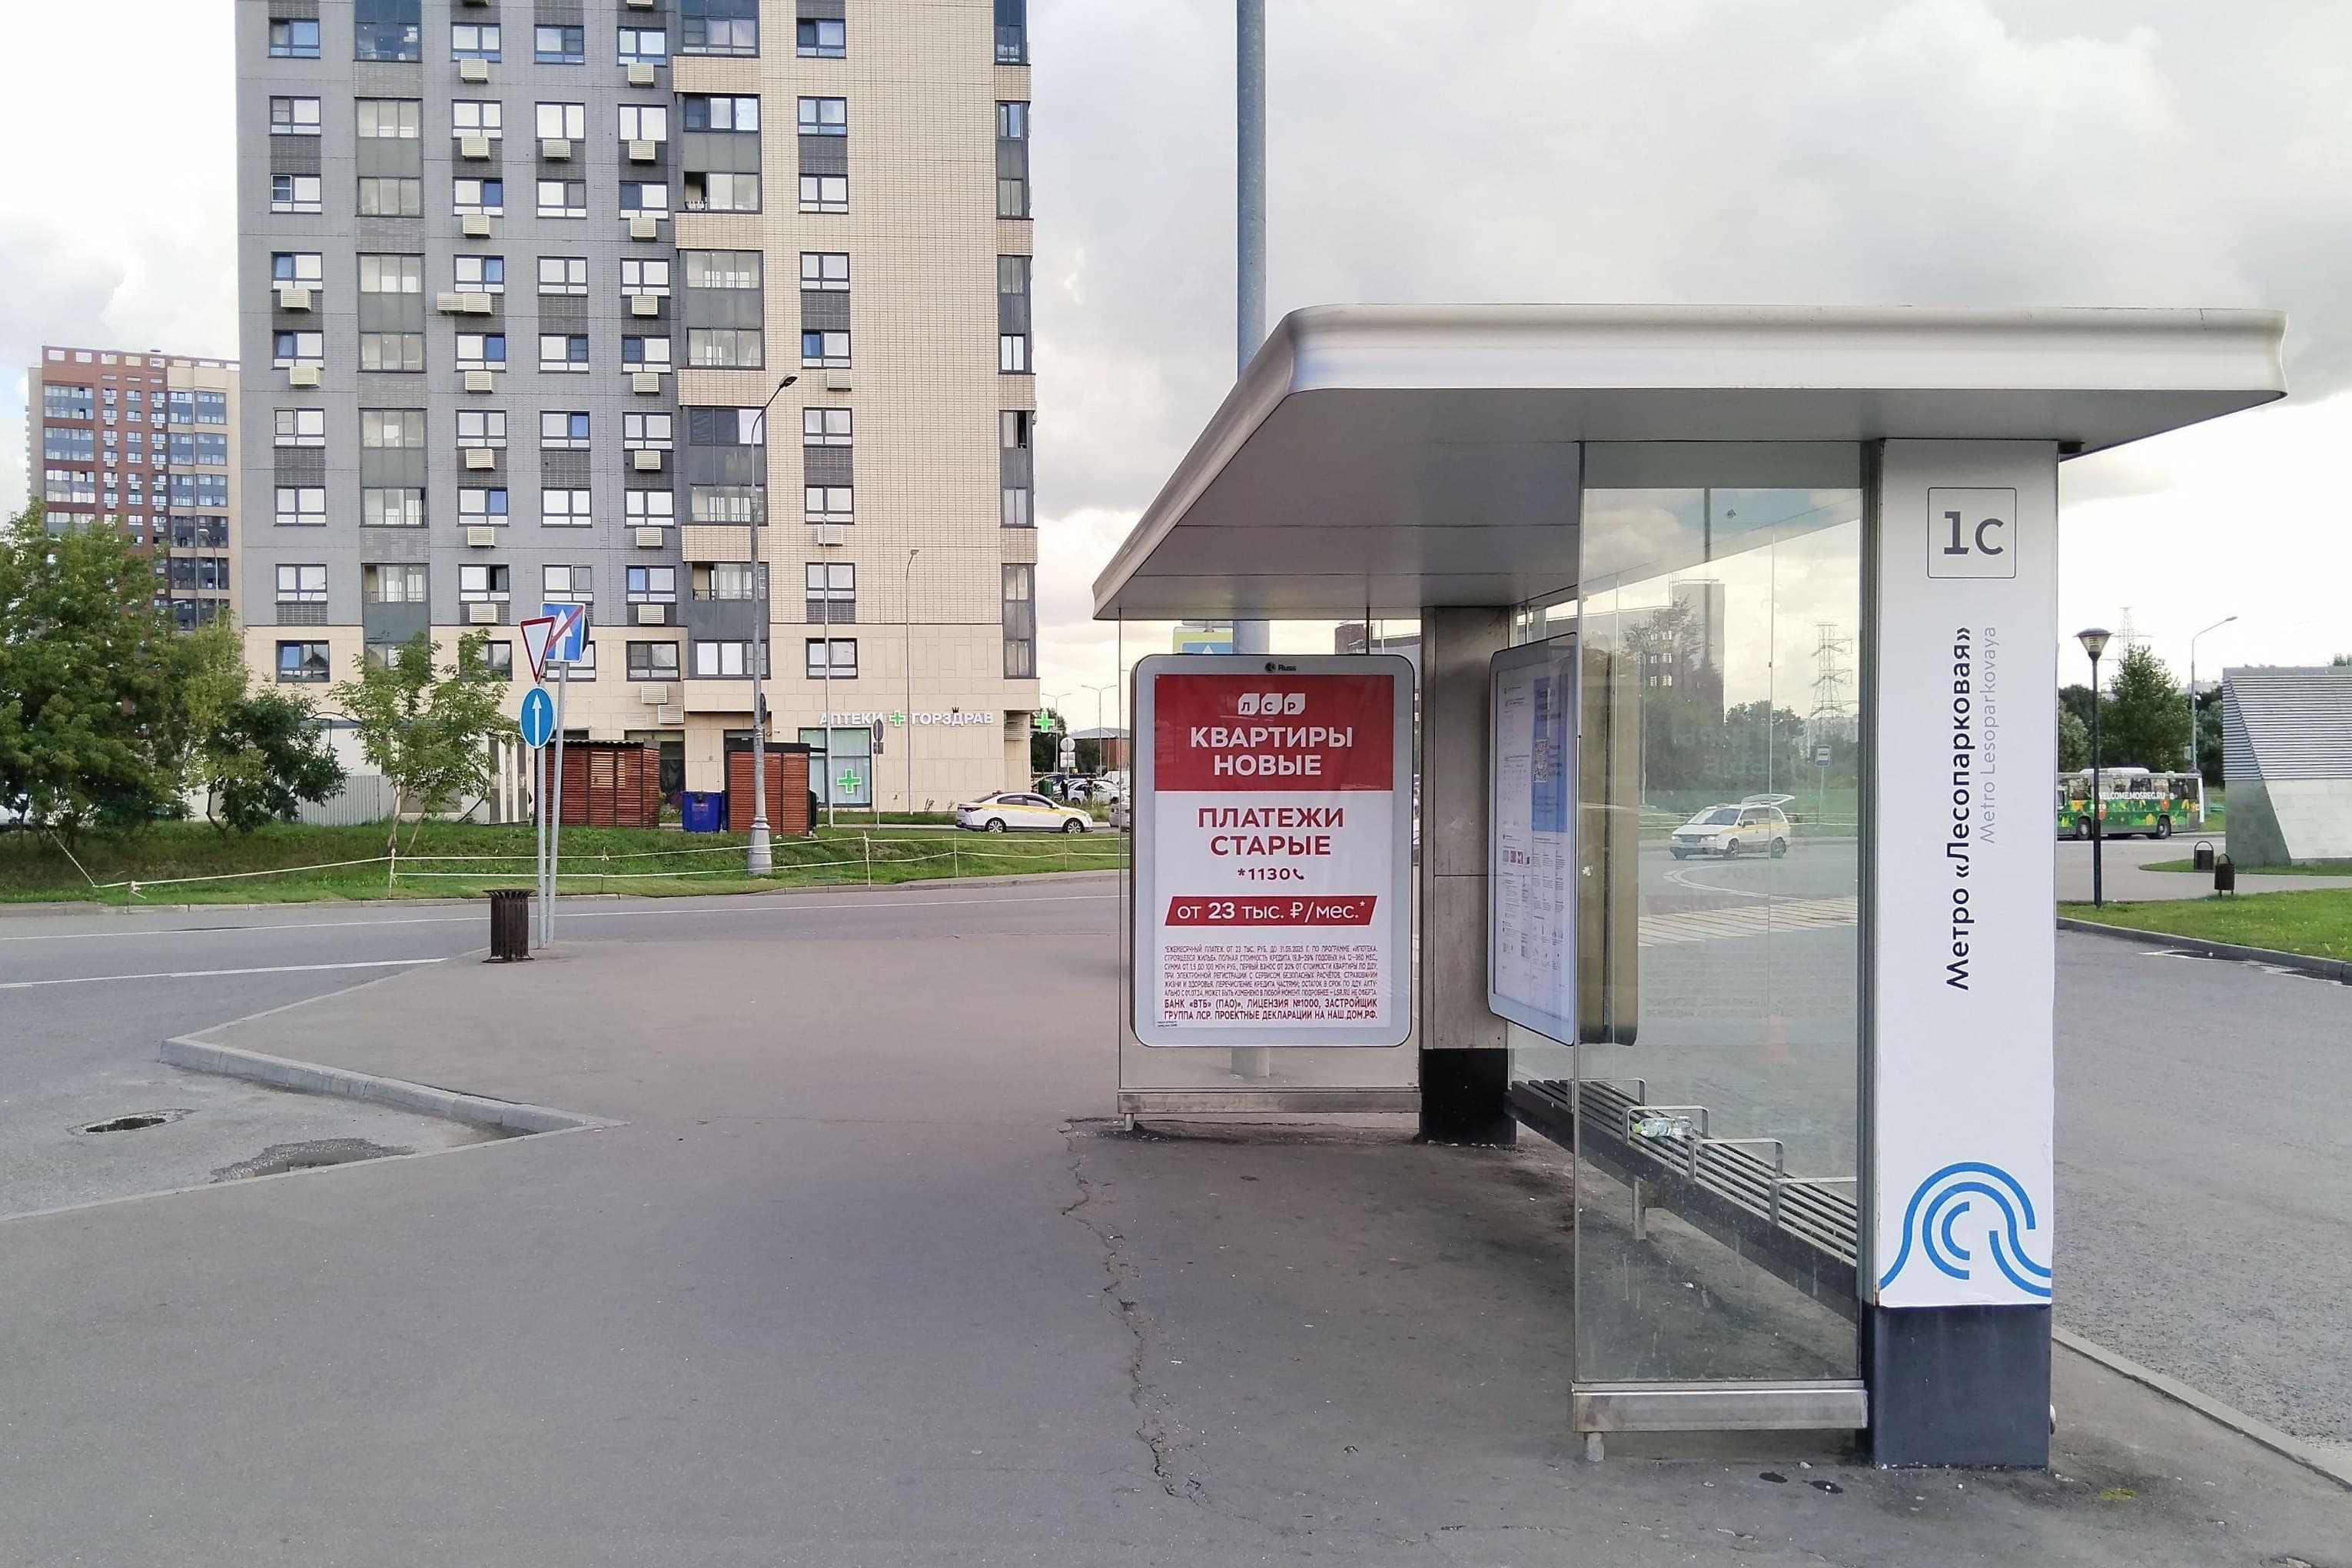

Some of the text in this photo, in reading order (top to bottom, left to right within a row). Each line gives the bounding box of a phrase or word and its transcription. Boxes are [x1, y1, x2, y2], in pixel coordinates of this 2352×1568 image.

[819, 712, 995, 726] АПТЕКИ ГОРЗДРАВ
[1189, 726, 1354, 749] КВАРТИРЫ
[1979, 626, 1998, 845] Metro Lesoparkovaya
[1213, 755, 1322, 776] НОВЫЕ
[1197, 807, 1344, 829] ПЛАТЕЖИ
[1945, 625, 1976, 992] Метро «Лесопарковая»
[1209, 835, 1332, 856] СТАРЫЕ
[1177, 905, 1202, 919] от
[1208, 902, 1235, 920] 23
[1241, 905, 1284, 920] тыс.
[1164, 998, 1185, 1008] БАНК
[1189, 998, 1211, 1008] «ВТБ»
[1247, 998, 1289, 1009] ЛИЦЕНЗИЯ
[1293, 998, 1321, 1010] №1000,
[1324, 997, 1377, 1009] ЗАСТРОЙЩИК
[1164, 1010, 1194, 1020] ГРУППА
[1196, 1010, 1212, 1020] ЛСР.
[1214, 1010, 1260, 1020] ПРОЕКТНЫЕ
[1261, 1010, 1312, 1021] ДЕКЛАРАЦИИ
[1314, 1010, 1325, 1020] НА
